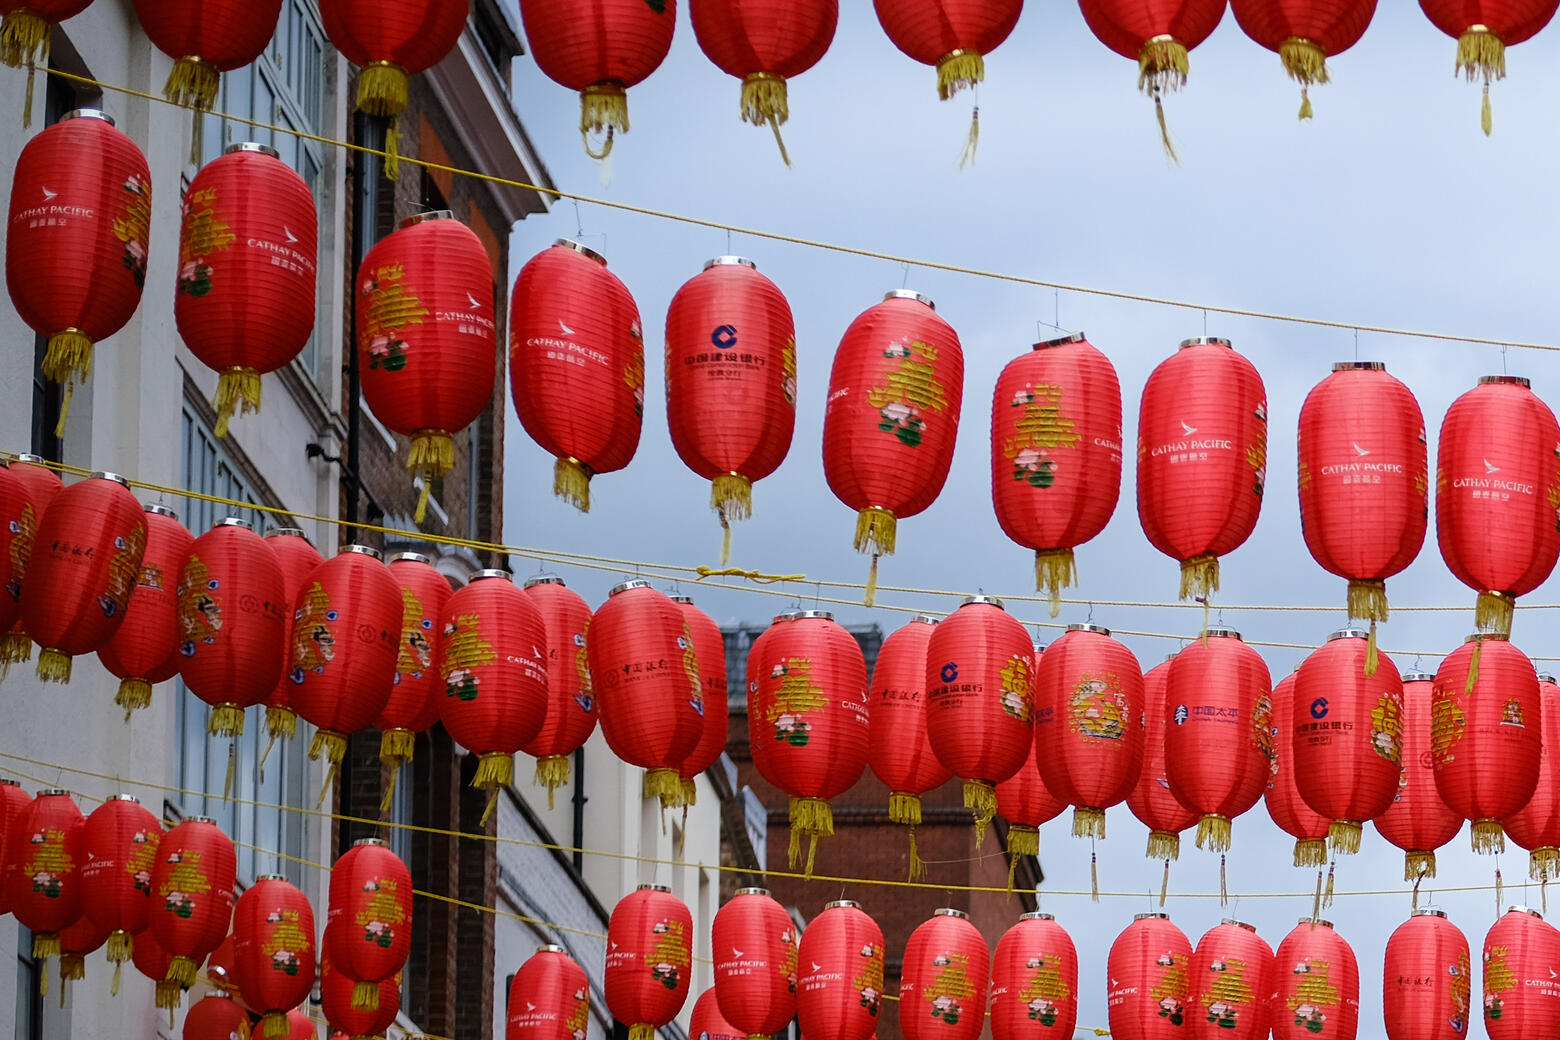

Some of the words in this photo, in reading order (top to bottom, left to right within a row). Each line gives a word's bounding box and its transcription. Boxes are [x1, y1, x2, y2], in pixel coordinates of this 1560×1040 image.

[14, 207, 48, 223] CATHAY
[50, 205, 93, 218] PACIFIC
[247, 238, 291, 256] CATHAY
[436, 312, 475, 323] CATHAY
[527, 337, 567, 348] CATHAY
[568, 342, 609, 366] PACIFIC
[1152, 441, 1188, 457] CATHAY
[1191, 439, 1232, 450] PACIFIC
[1321, 463, 1362, 474] CATHAY
[1364, 463, 1402, 474] PACIFIC
[1453, 478, 1491, 489] CATHAY
[1493, 480, 1533, 494] PACIFIC
[1192, 706, 1238, 717] 中国太平
[816, 973, 843, 981] PACIFIC
[1525, 979, 1553, 988] CATHAY
[1114, 988, 1138, 996] PACIFIC
[531, 1013, 556, 1021] PACIFIC
